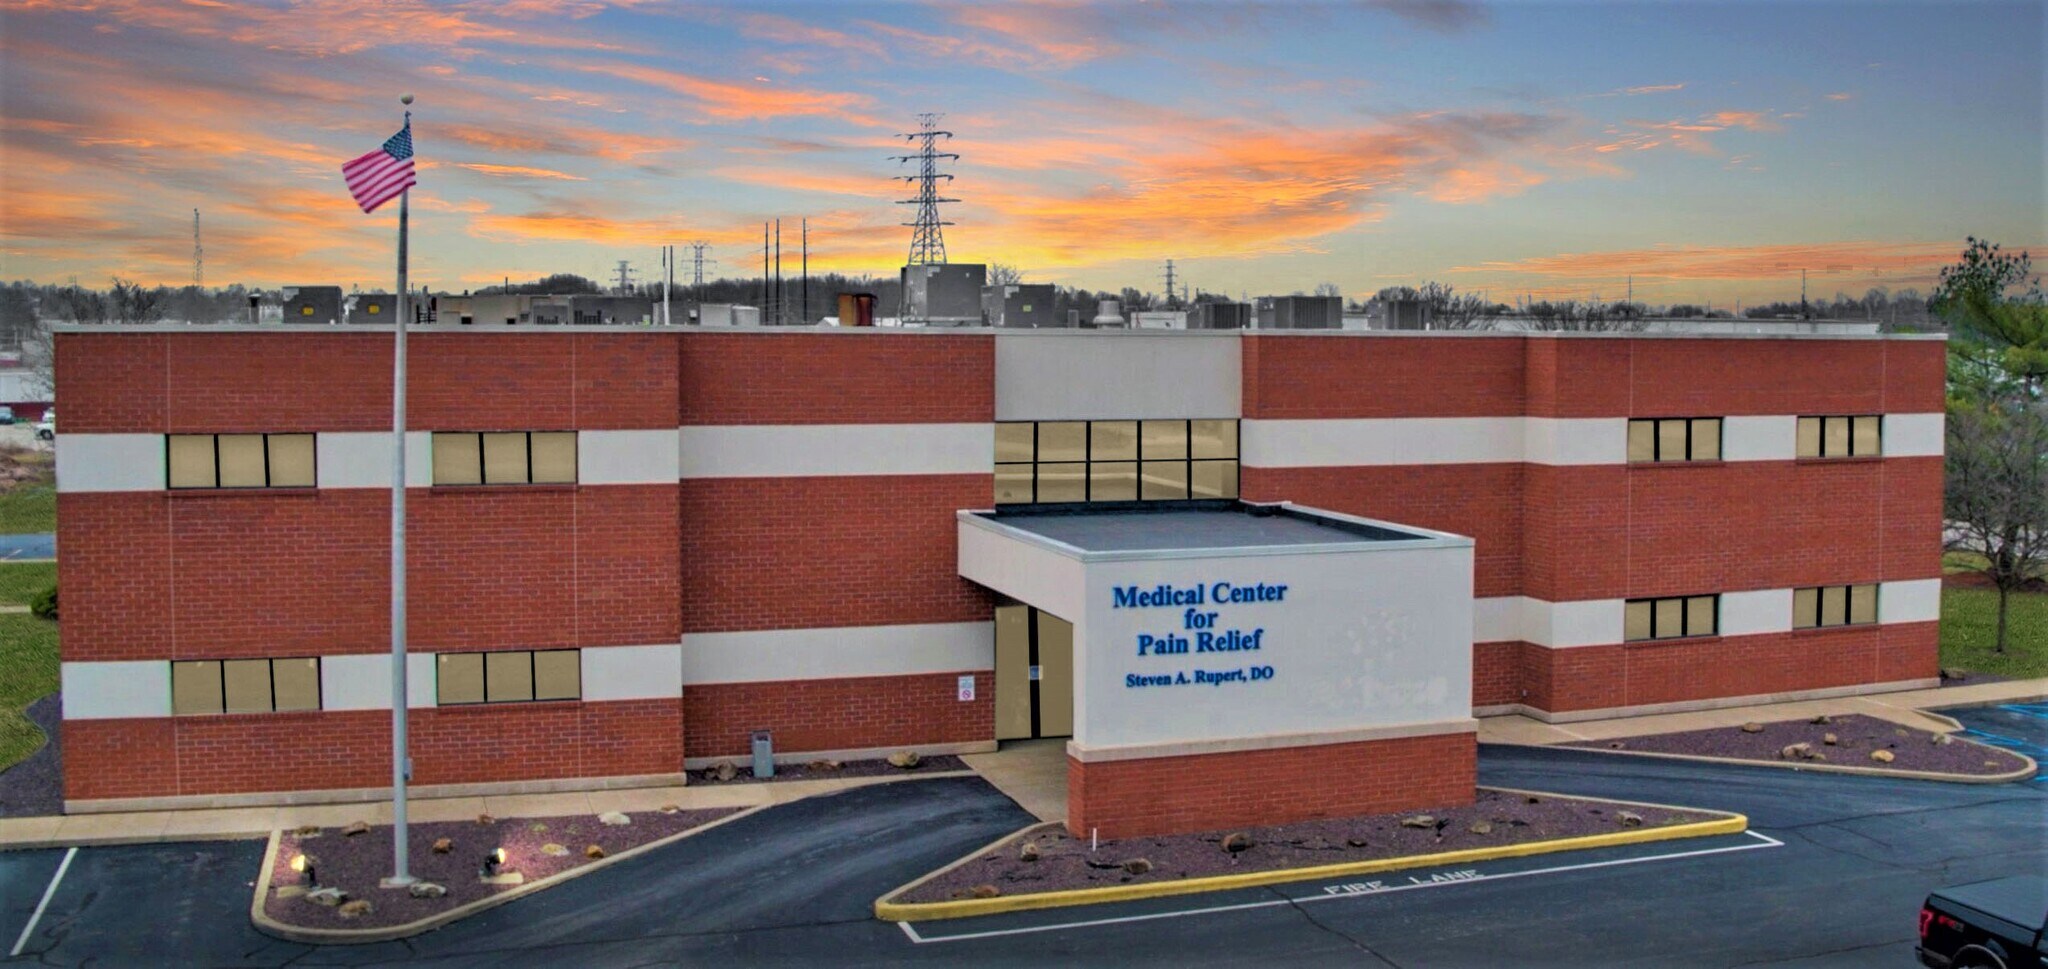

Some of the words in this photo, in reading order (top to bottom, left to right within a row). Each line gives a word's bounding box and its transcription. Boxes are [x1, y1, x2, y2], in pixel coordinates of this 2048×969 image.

[1112, 583, 1205, 608] Medical
[1211, 581, 1288, 604] Center
[1183, 607, 1219, 629] for
[1137, 633, 1189, 656] Pain
[1195, 628, 1264, 653] Relief
[1125, 673, 1172, 688] Steven
[1174, 671, 1191, 685] A.
[1194, 668, 1247, 685] Rupert,
[1250, 665, 1274, 681] DO
[1323, 880, 1391, 896] FIRE
[1408, 869, 1485, 886] LANE
